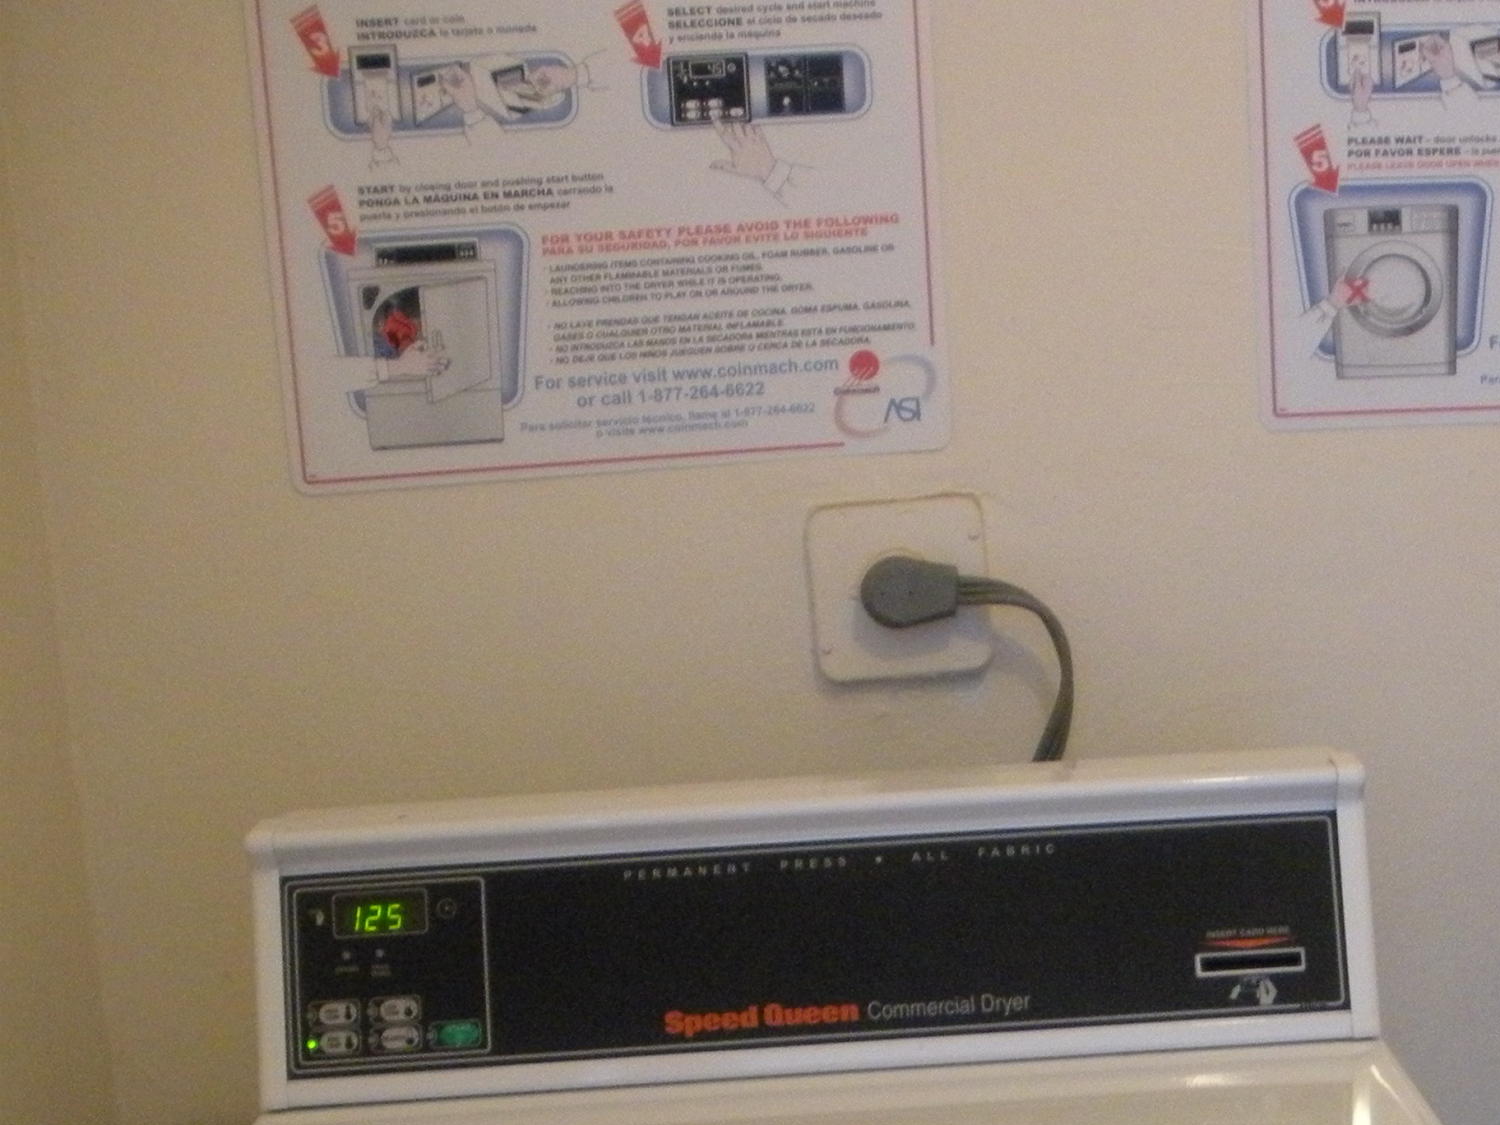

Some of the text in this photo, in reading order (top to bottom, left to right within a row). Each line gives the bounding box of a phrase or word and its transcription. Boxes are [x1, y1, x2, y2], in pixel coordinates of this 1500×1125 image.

[667, 5, 712, 16] SELECT
[756, 1, 782, 13] cycle
[356, 16, 398, 27] INSERT
[668, 17, 742, 29] SELECCIONE
[1347, 136, 1390, 145] PLEASE
[1394, 135, 1422, 144] WAIT
[1347, 147, 1460, 157] POR FAVOR ESPERE
[357, 184, 394, 194] START
[480, 178, 499, 187] and
[358, 196, 400, 207] PONGA
[404, 195, 418, 204] LA
[482, 190, 498, 199] EN
[502, 187, 552, 198] MARCHA
[326, 212, 342, 234] 5
[542, 214, 899, 244] FOR YOUR SAFETY PLEASE AVOID THE FOLLOWING
[534, 358, 838, 389] For service visit www.coinmach.com
[577, 383, 764, 406] or call 1-877-264-6622
[623, 843, 1056, 880] PERMANENT PRESS ALL FABRIC
[355, 903, 401, 932] 125
[663, 992, 1030, 1038] Speed Queen Commercial Dryer
